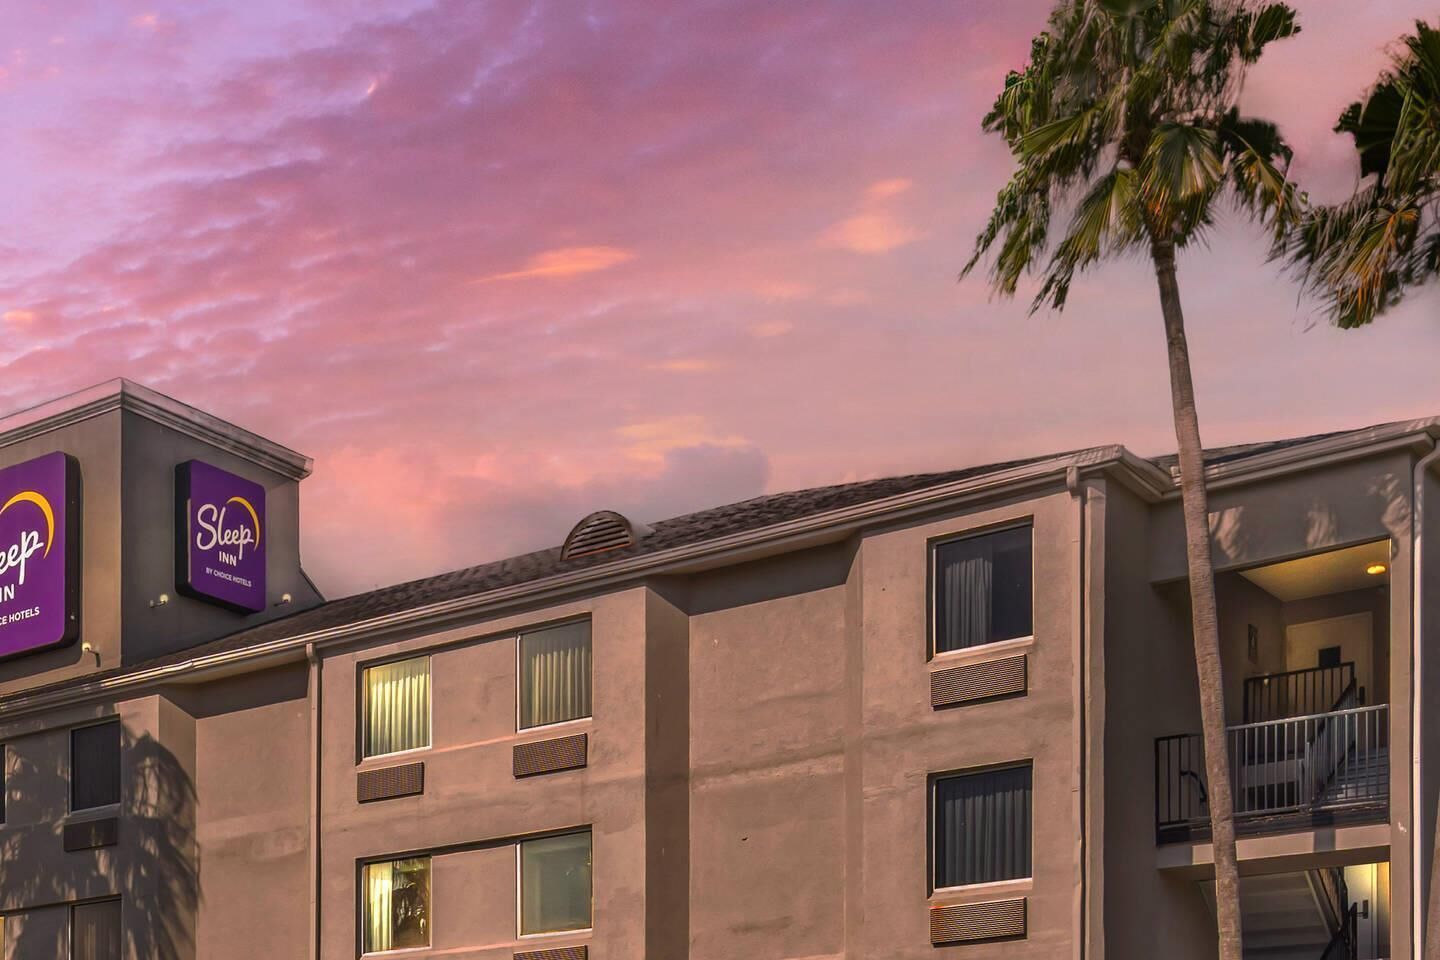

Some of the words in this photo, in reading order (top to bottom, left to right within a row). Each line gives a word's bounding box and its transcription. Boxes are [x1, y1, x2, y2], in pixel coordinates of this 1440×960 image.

[197, 503, 254, 560] Sleep
[218, 551, 237, 567] INN
[205, 566, 213, 575] BY
[213, 569, 232, 582] CHOICE
[232, 576, 252, 587] HOTELS
[9, 606, 40, 623] HOTELS
